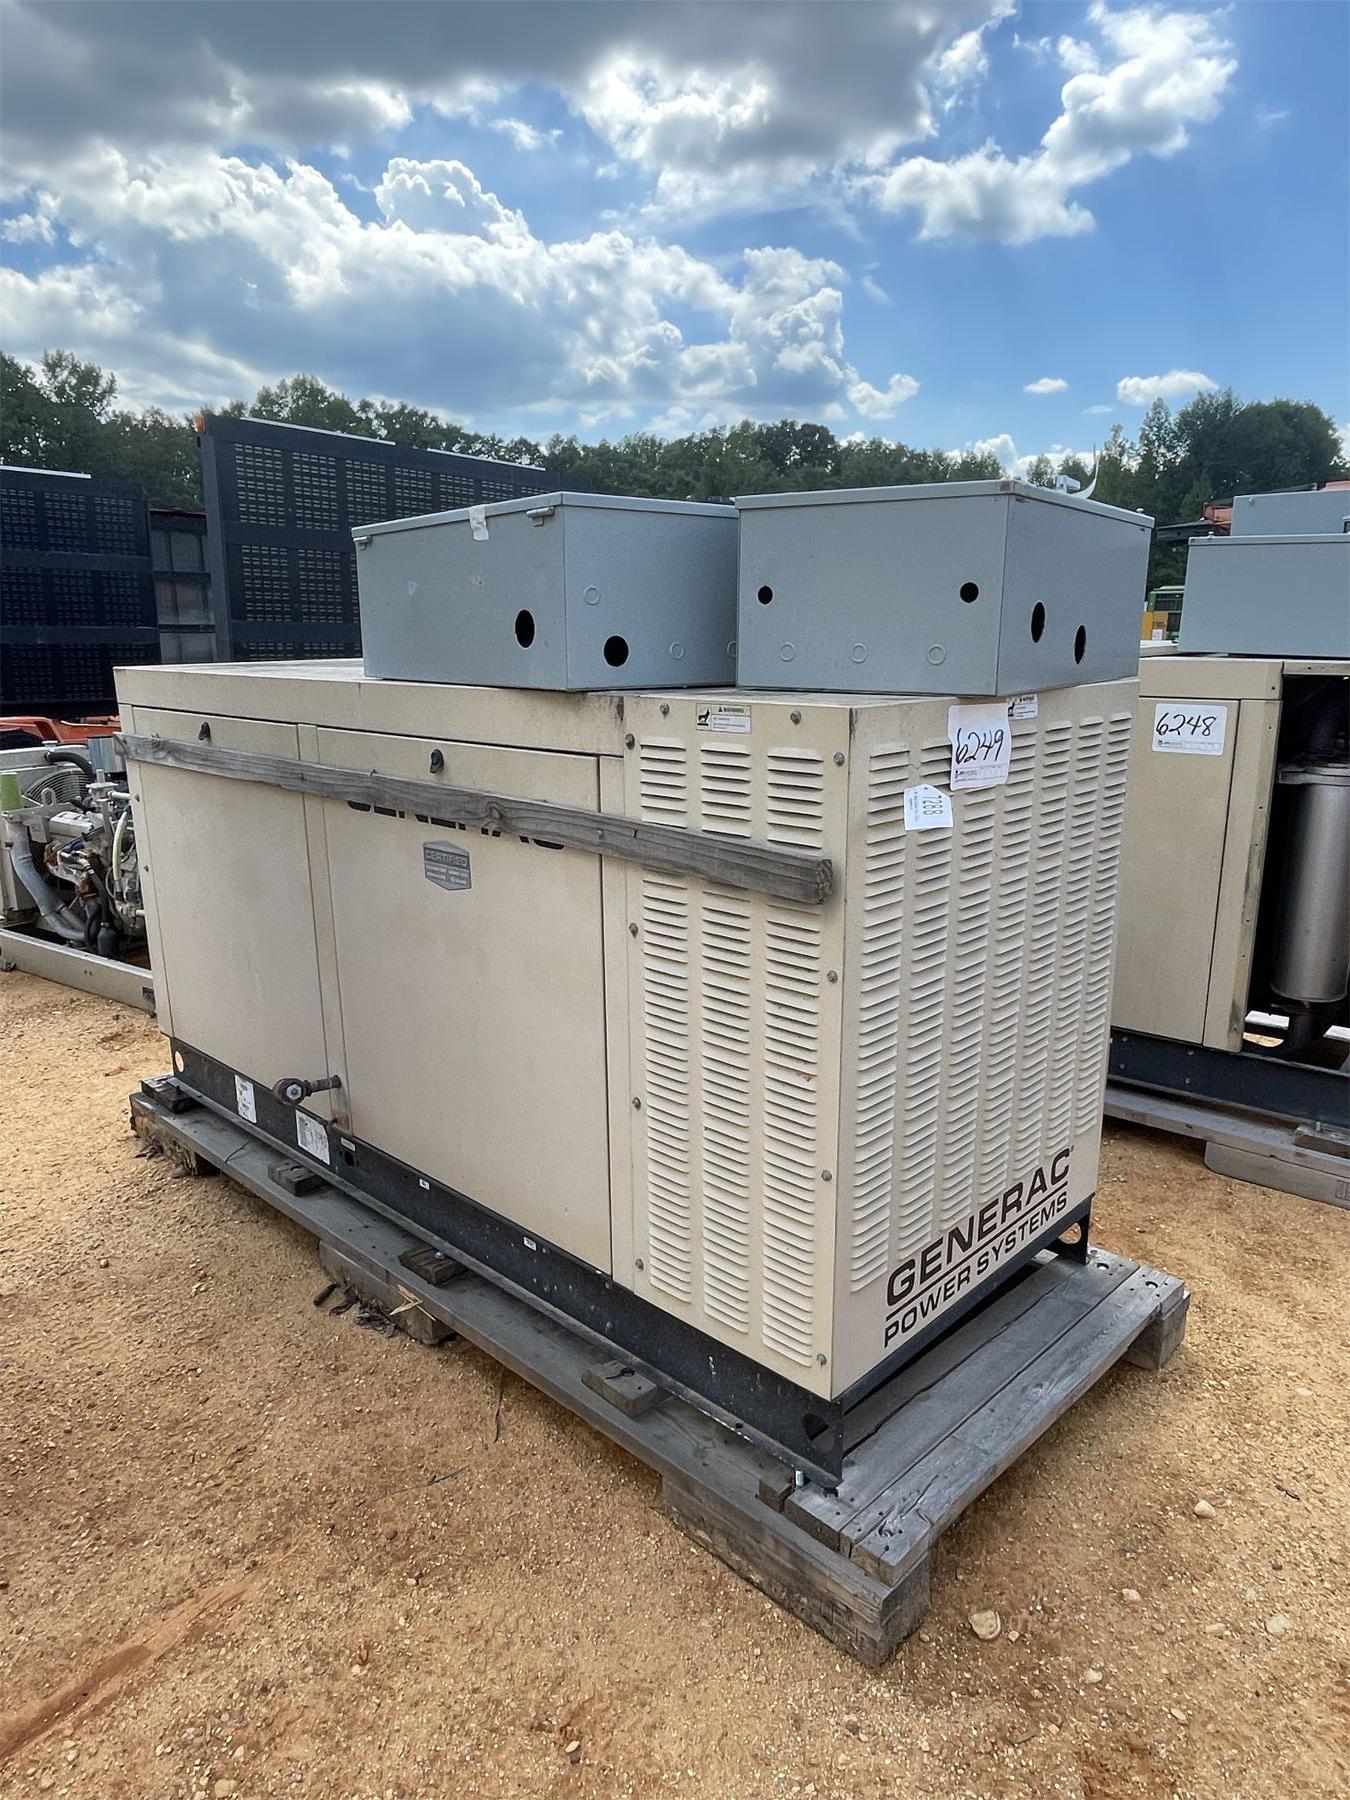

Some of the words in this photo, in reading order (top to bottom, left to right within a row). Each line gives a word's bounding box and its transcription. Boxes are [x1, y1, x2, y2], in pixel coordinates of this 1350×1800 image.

[1156, 712, 1217, 737] 6248
[955, 727, 1005, 765] 6249
[425, 849, 468, 867] CERTIFIED
[886, 1147, 1071, 1307] GENERAC
[884, 1265, 971, 1348] POWER
[976, 1191, 1068, 1276] SYSTEMS
